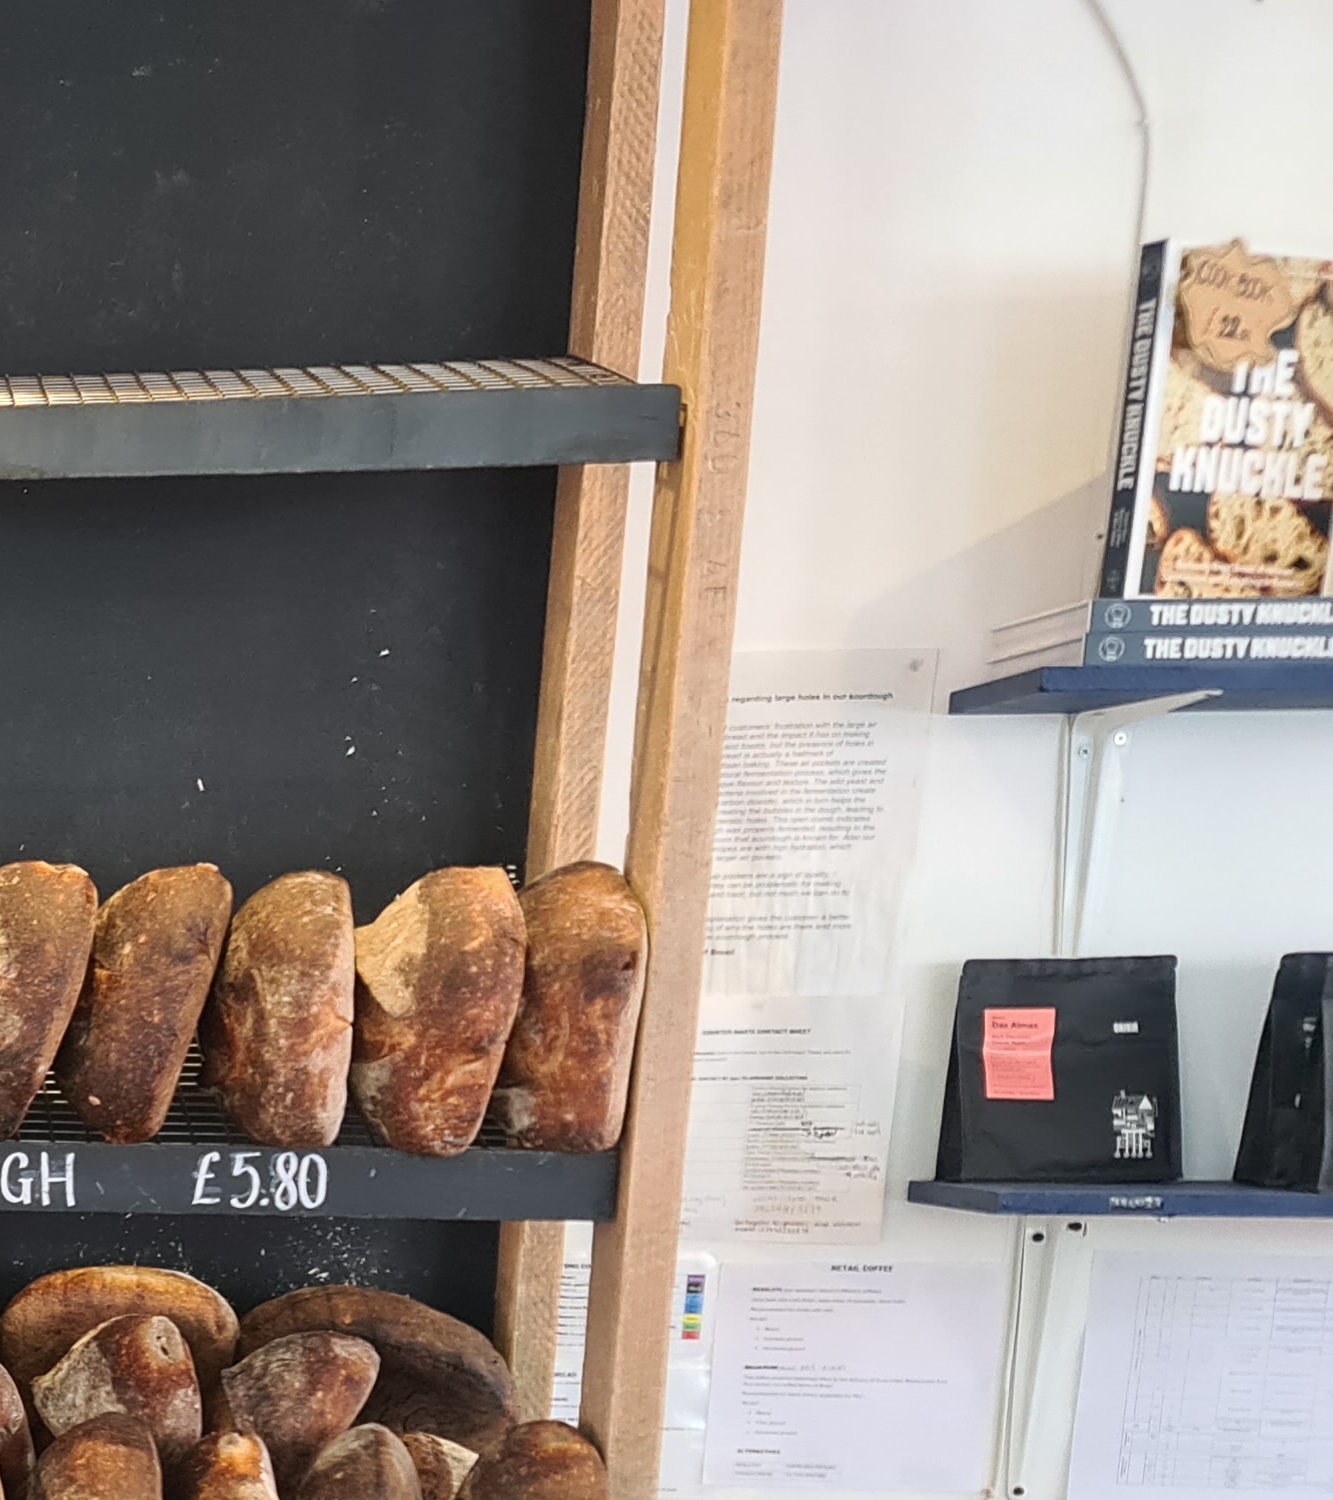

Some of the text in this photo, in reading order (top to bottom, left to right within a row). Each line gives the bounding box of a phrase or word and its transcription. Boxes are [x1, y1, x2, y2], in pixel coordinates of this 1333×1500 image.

[1201, 396, 1316, 449] DUSTY
[1169, 446, 1329, 502] KNUCKLE
[1150, 603, 1188, 626] THE
[1190, 603, 1256, 626] DUSTY
[1144, 636, 1333, 660] THE DUSTY KNUCKL
[190, 1150, 330, 1209] £5.80
